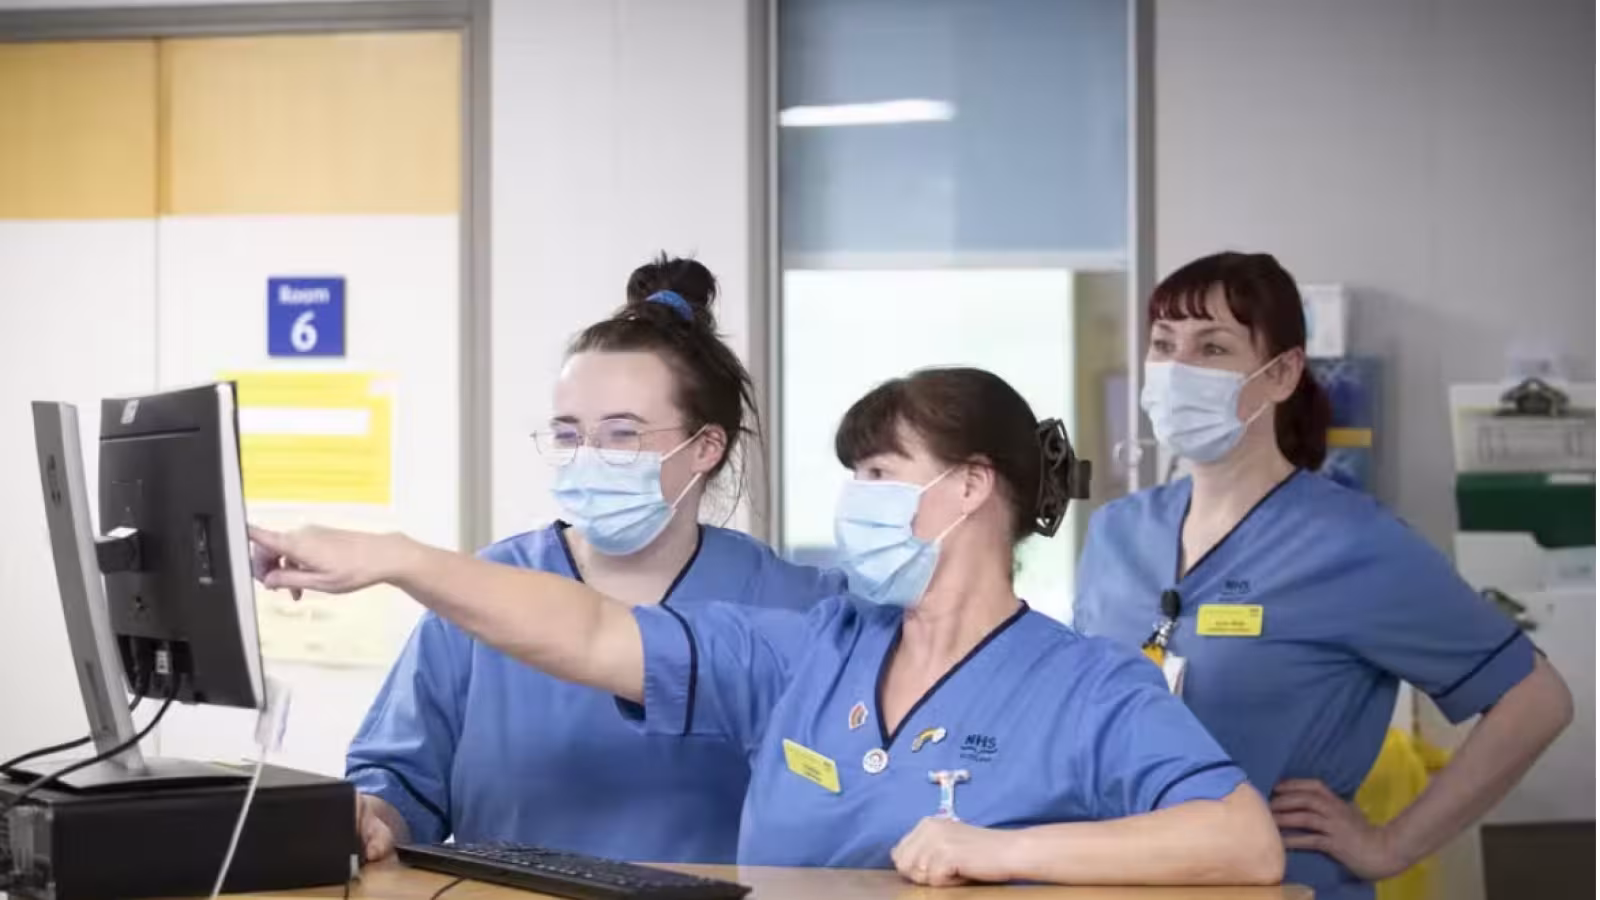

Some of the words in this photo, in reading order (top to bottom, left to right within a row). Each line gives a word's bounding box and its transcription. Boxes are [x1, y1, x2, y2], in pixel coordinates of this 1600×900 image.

[279, 285, 331, 304] Room
[292, 311, 317, 352] 6
[964, 734, 997, 749] NHS
